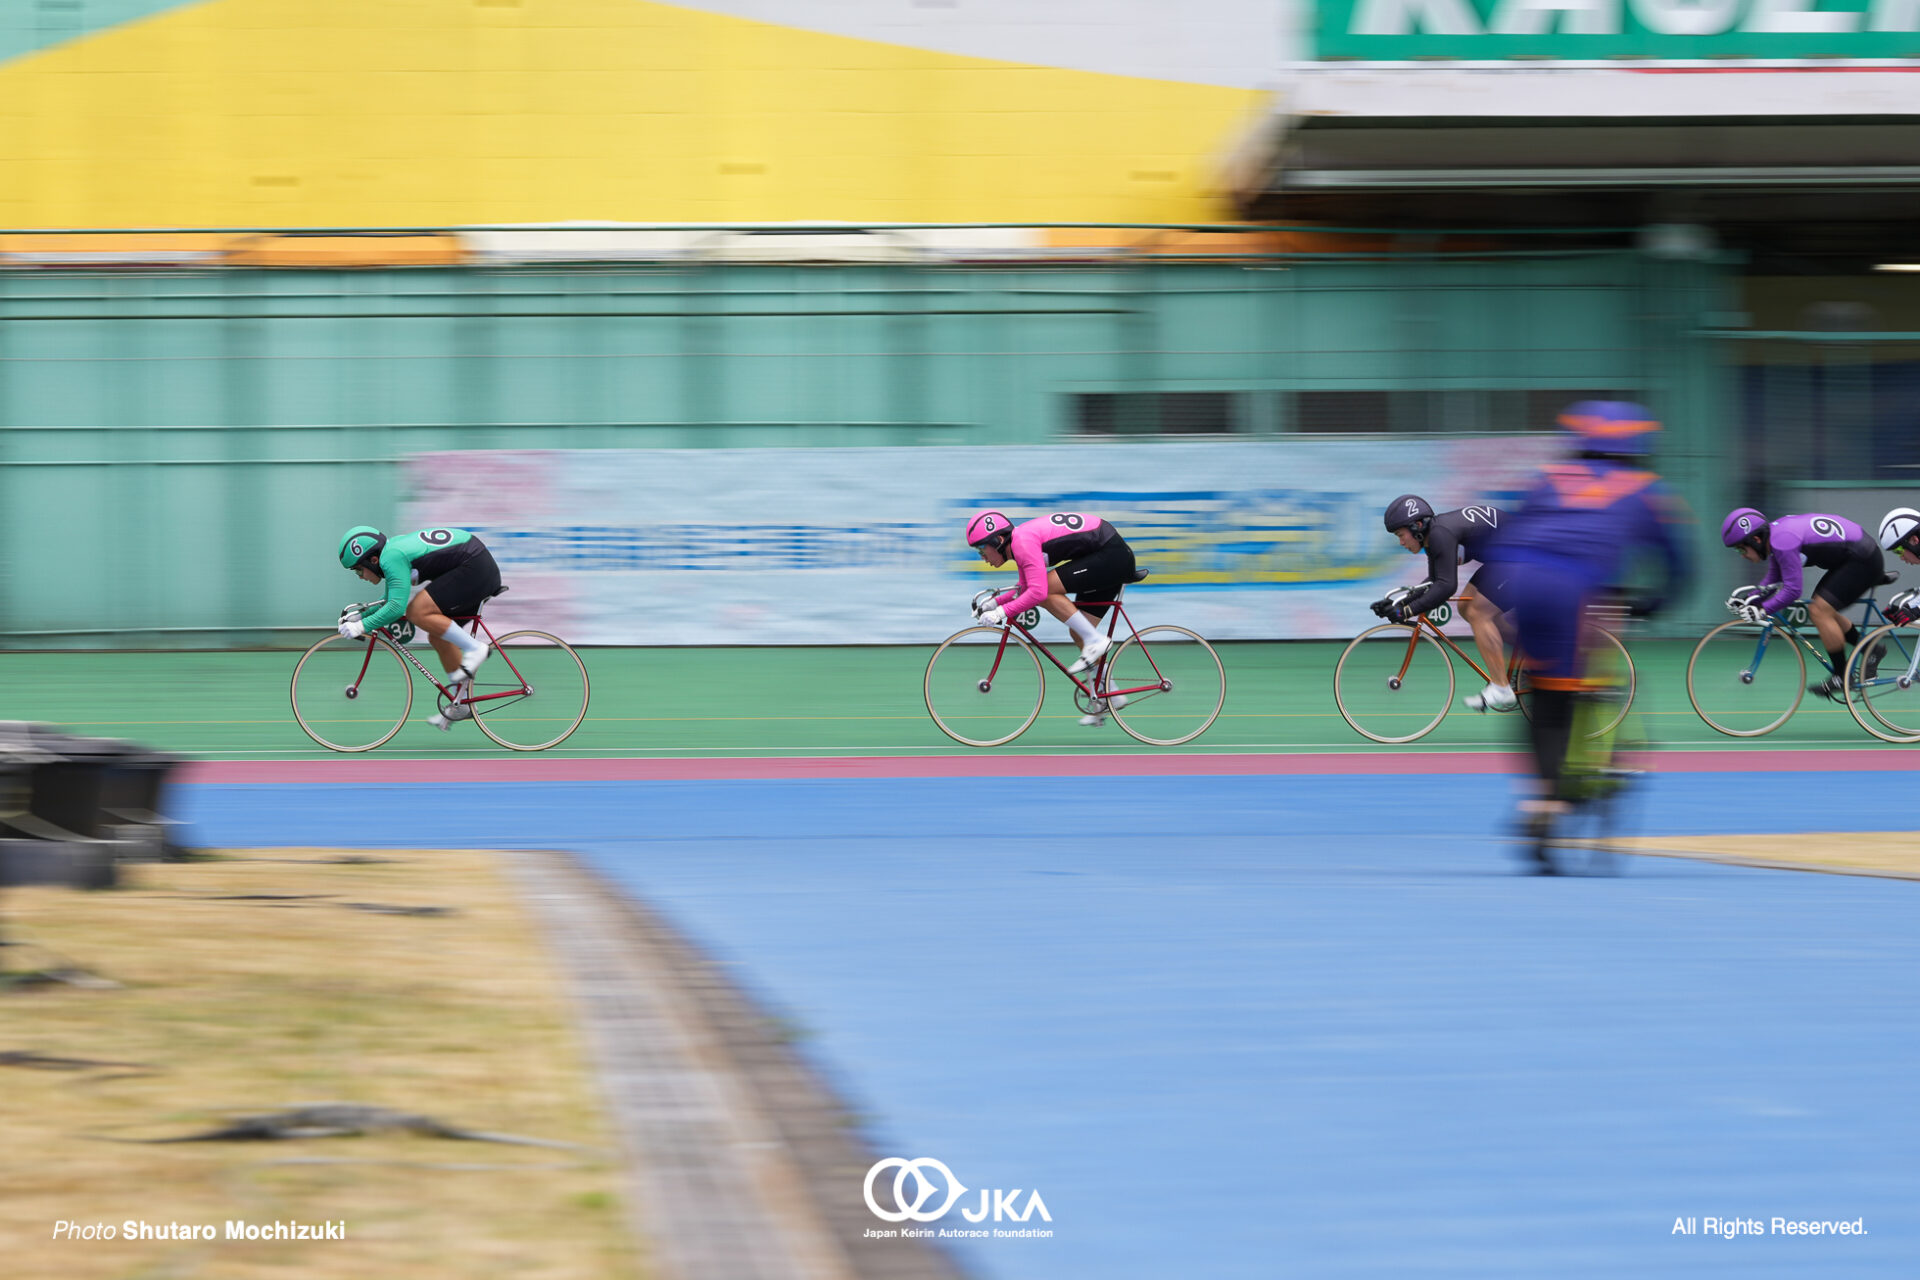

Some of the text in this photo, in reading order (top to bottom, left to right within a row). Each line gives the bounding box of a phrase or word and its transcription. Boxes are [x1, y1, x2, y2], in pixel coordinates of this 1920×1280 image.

[1405, 499, 1419, 518] 2
[1462, 505, 1498, 528] 2
[984, 516, 996, 532] 8
[1050, 512, 1084, 530] 8
[1738, 517, 1751, 534] 9
[1810, 516, 1846, 540] 9
[418, 528, 453, 546] 6
[1890, 523, 1900, 538] 1
[351, 540, 363, 556] 6
[1016, 609, 1036, 626] 43
[1428, 605, 1449, 621] 40
[1787, 606, 1807, 623] 70
[391, 621, 413, 640] 34
